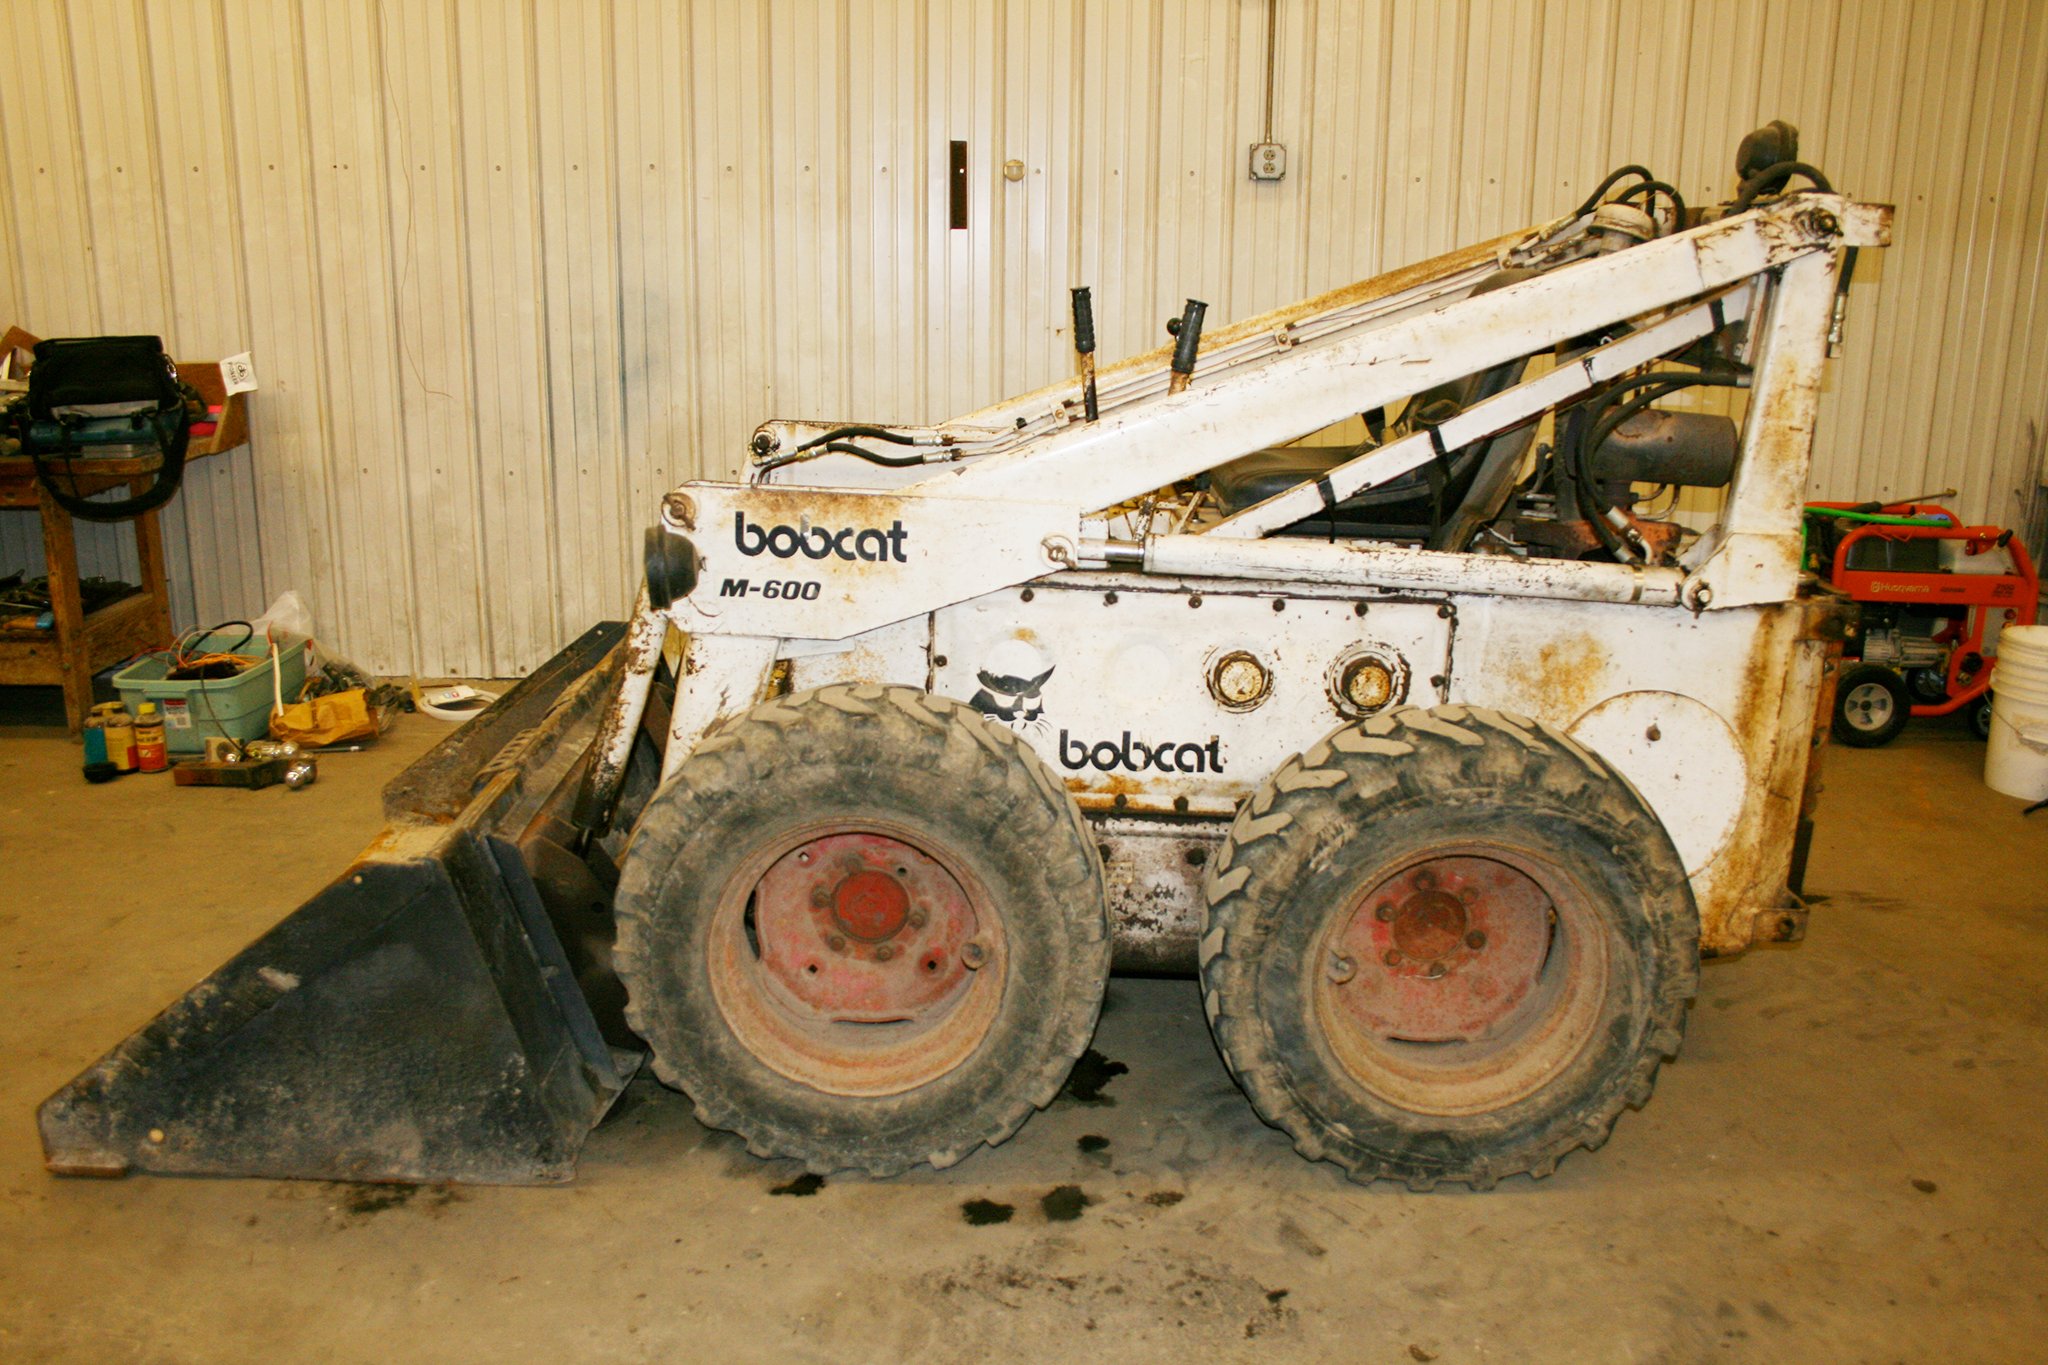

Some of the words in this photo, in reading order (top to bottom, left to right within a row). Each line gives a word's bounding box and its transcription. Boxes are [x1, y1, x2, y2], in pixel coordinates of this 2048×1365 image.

[735, 511, 908, 563] bobcat
[720, 578, 822, 600] M-600
[1059, 729, 1223, 773] bobcat
